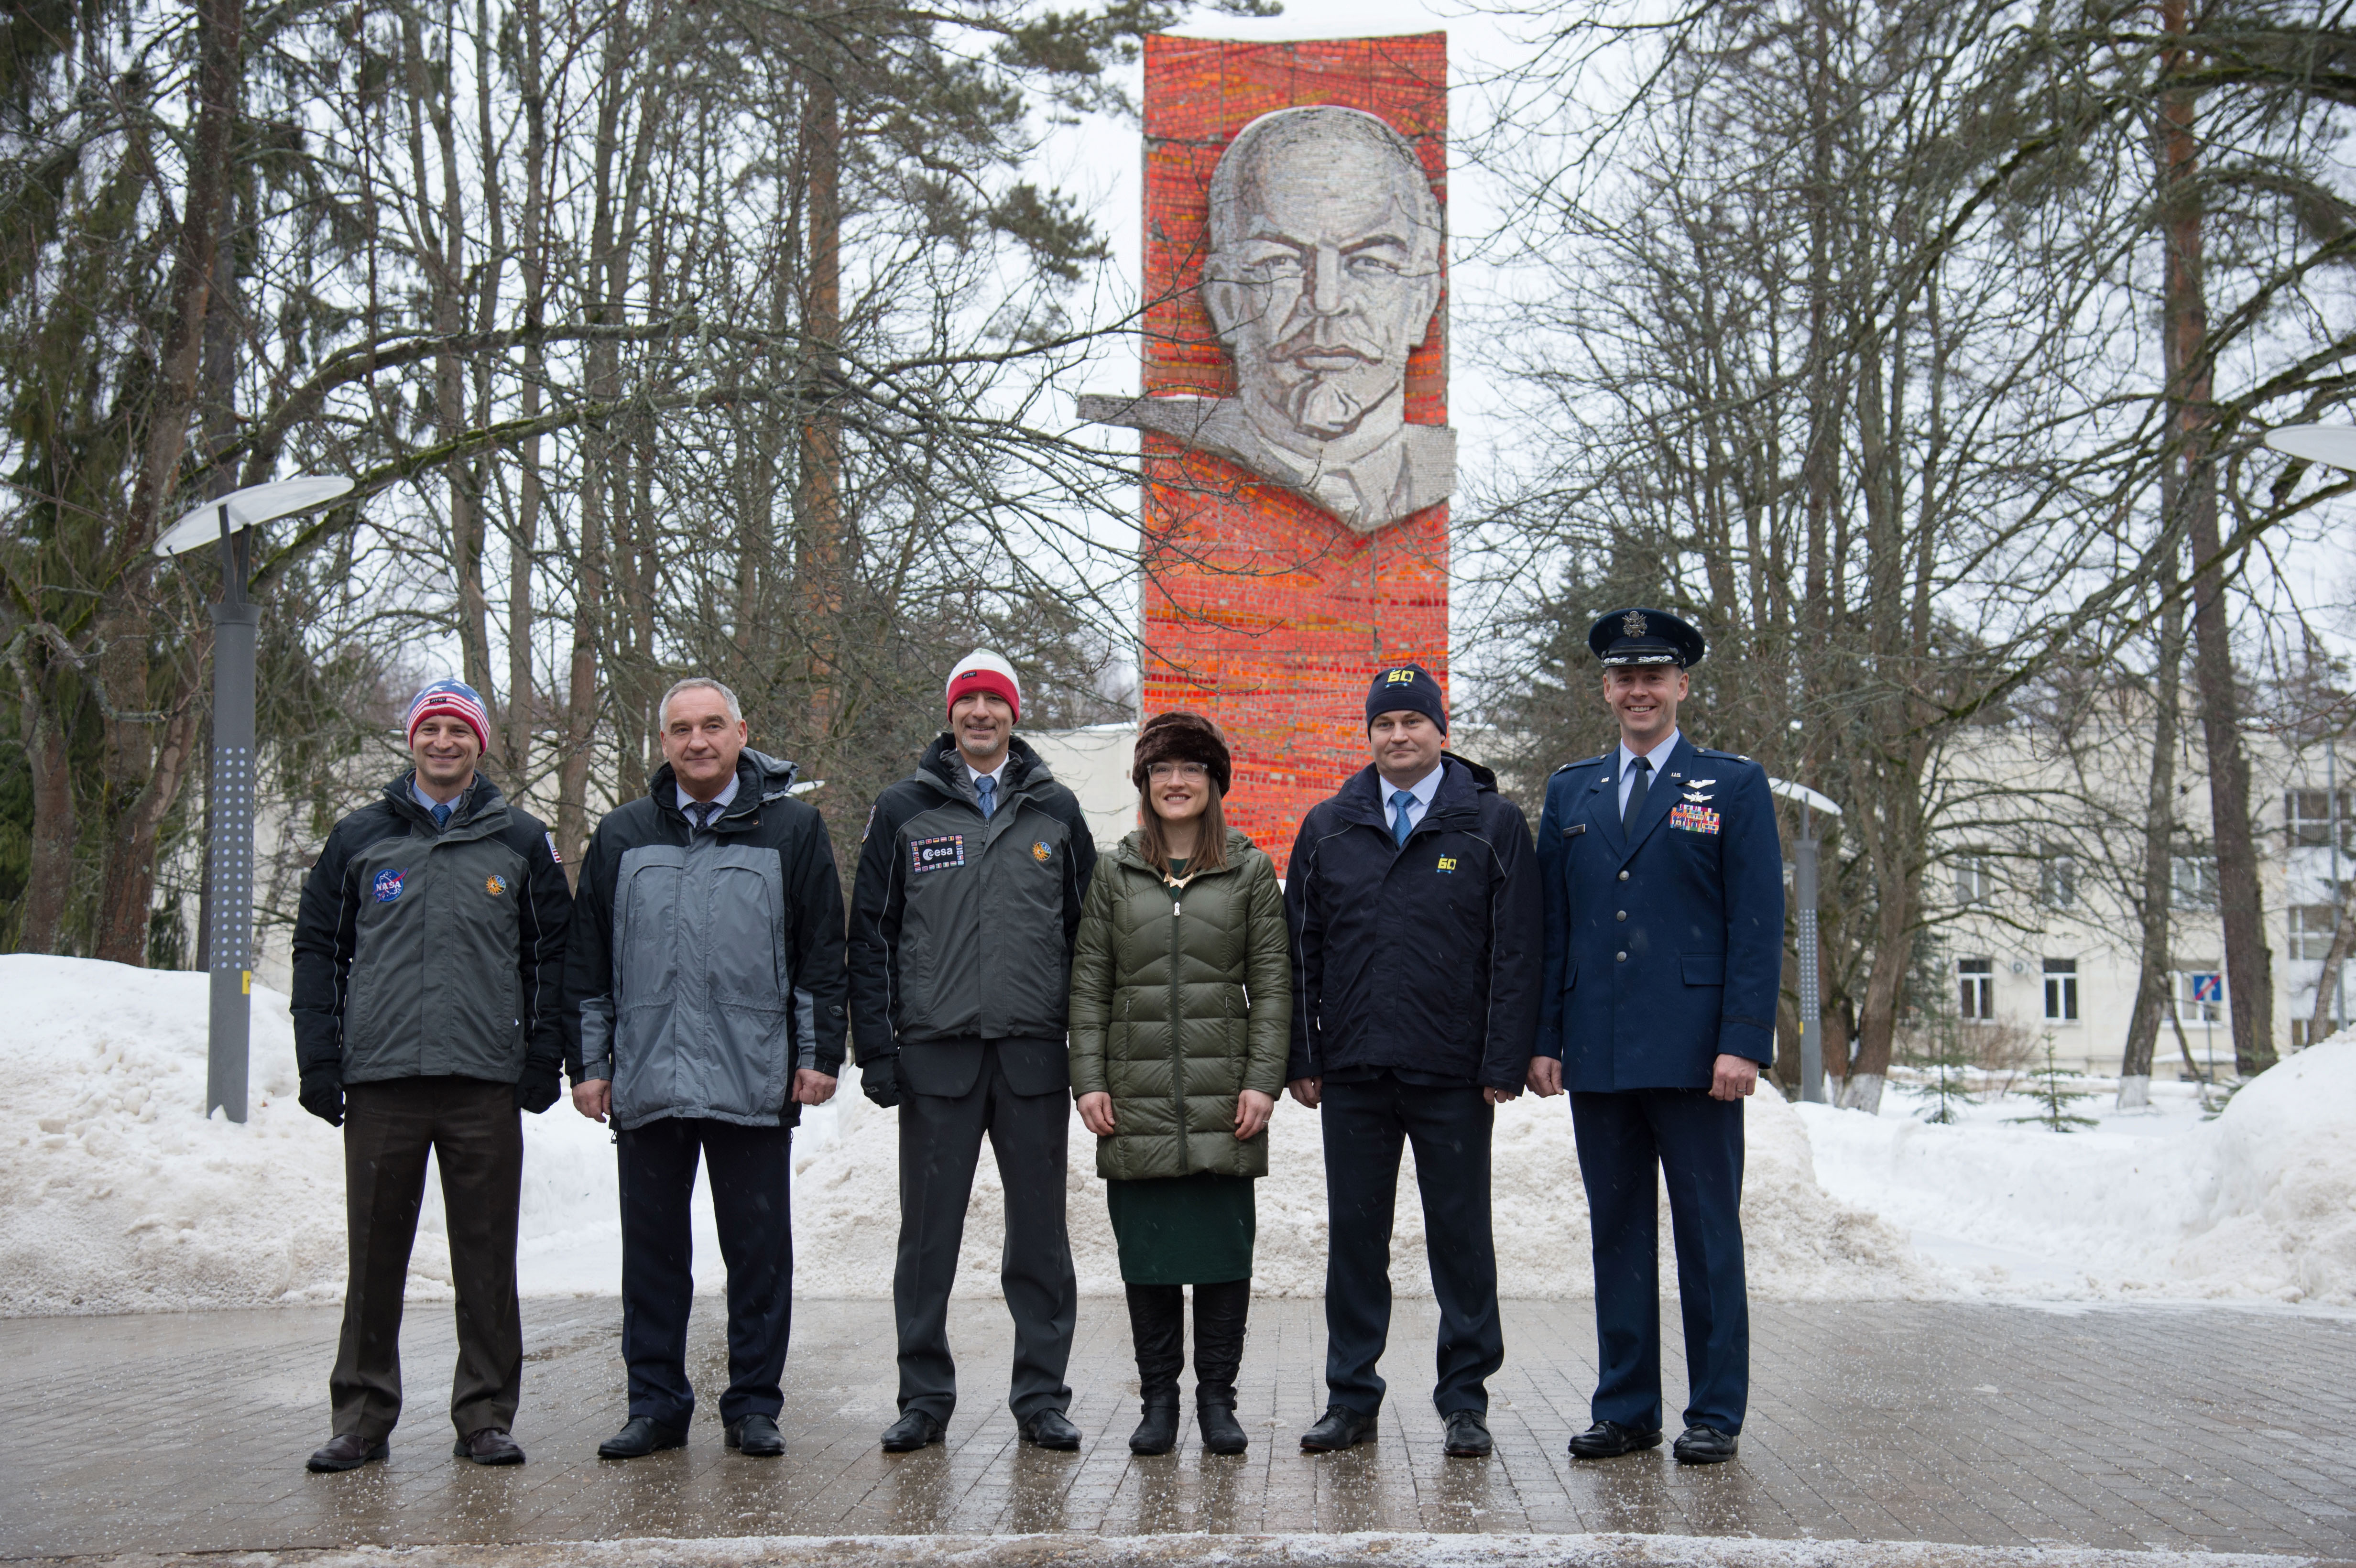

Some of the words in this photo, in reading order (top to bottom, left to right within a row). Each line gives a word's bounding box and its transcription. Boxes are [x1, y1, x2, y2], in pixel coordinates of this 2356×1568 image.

[1387, 670, 1414, 682] 60
[1438, 858, 1457, 870] 60
[376, 881, 402, 891] NASA
